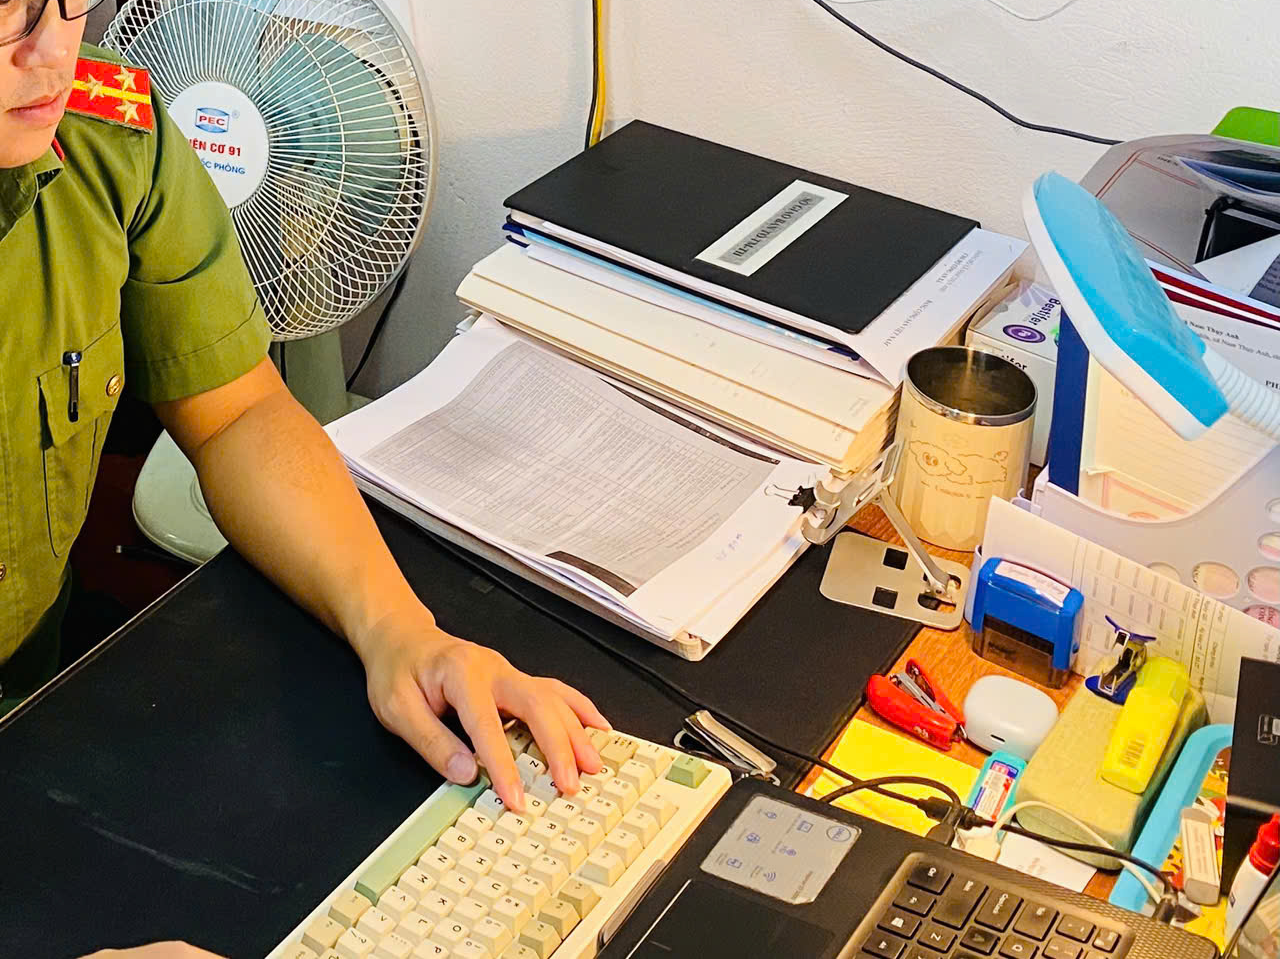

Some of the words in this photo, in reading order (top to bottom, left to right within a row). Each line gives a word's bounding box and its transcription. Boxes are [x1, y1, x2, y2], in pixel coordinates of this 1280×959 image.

[198, 115, 226, 126] PEC
[228, 146, 241, 157] 91
[214, 162, 246, 175] PHÒNG
[565, 803, 575, 811] E
[477, 816, 486, 824] V
[516, 818, 523, 826] F
[457, 835, 467, 843] B
[437, 854, 448, 863] N
[476, 857, 486, 865] H
[417, 874, 429, 884] M
[491, 883, 502, 891] U
[437, 897, 448, 906] K
[452, 925, 462, 933] O
[434, 946, 442, 954] P
